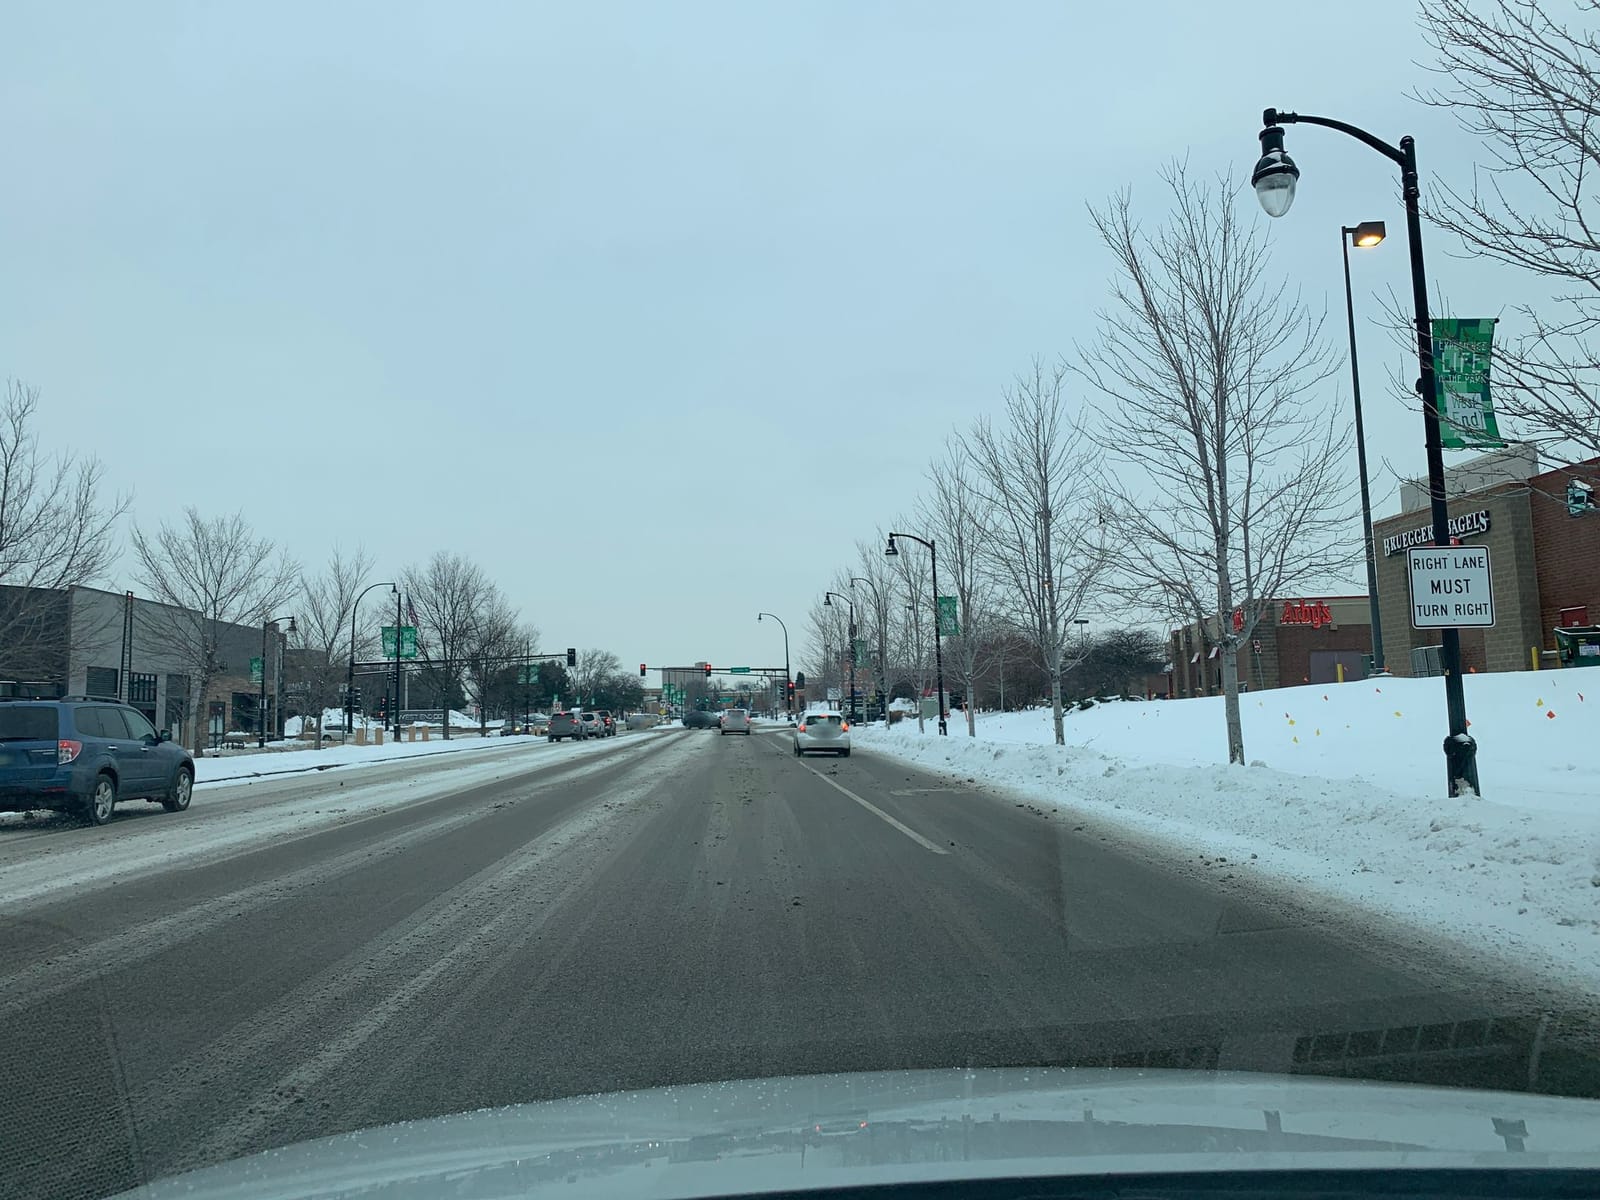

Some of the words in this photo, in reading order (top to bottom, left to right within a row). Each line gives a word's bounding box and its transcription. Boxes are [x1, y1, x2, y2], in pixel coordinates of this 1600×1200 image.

[1441, 352, 1484, 374] LIFE
[1451, 411, 1478, 427] End
[1383, 525, 1435, 557] BRUEGGER
[1413, 557, 1448, 570] RIGHT
[1454, 556, 1485, 569] LANE
[1430, 579, 1471, 594] MUST
[1281, 600, 1333, 629] Arby's
[1416, 604, 1448, 617] TURN
[1455, 603, 1489, 616] RIGHT
